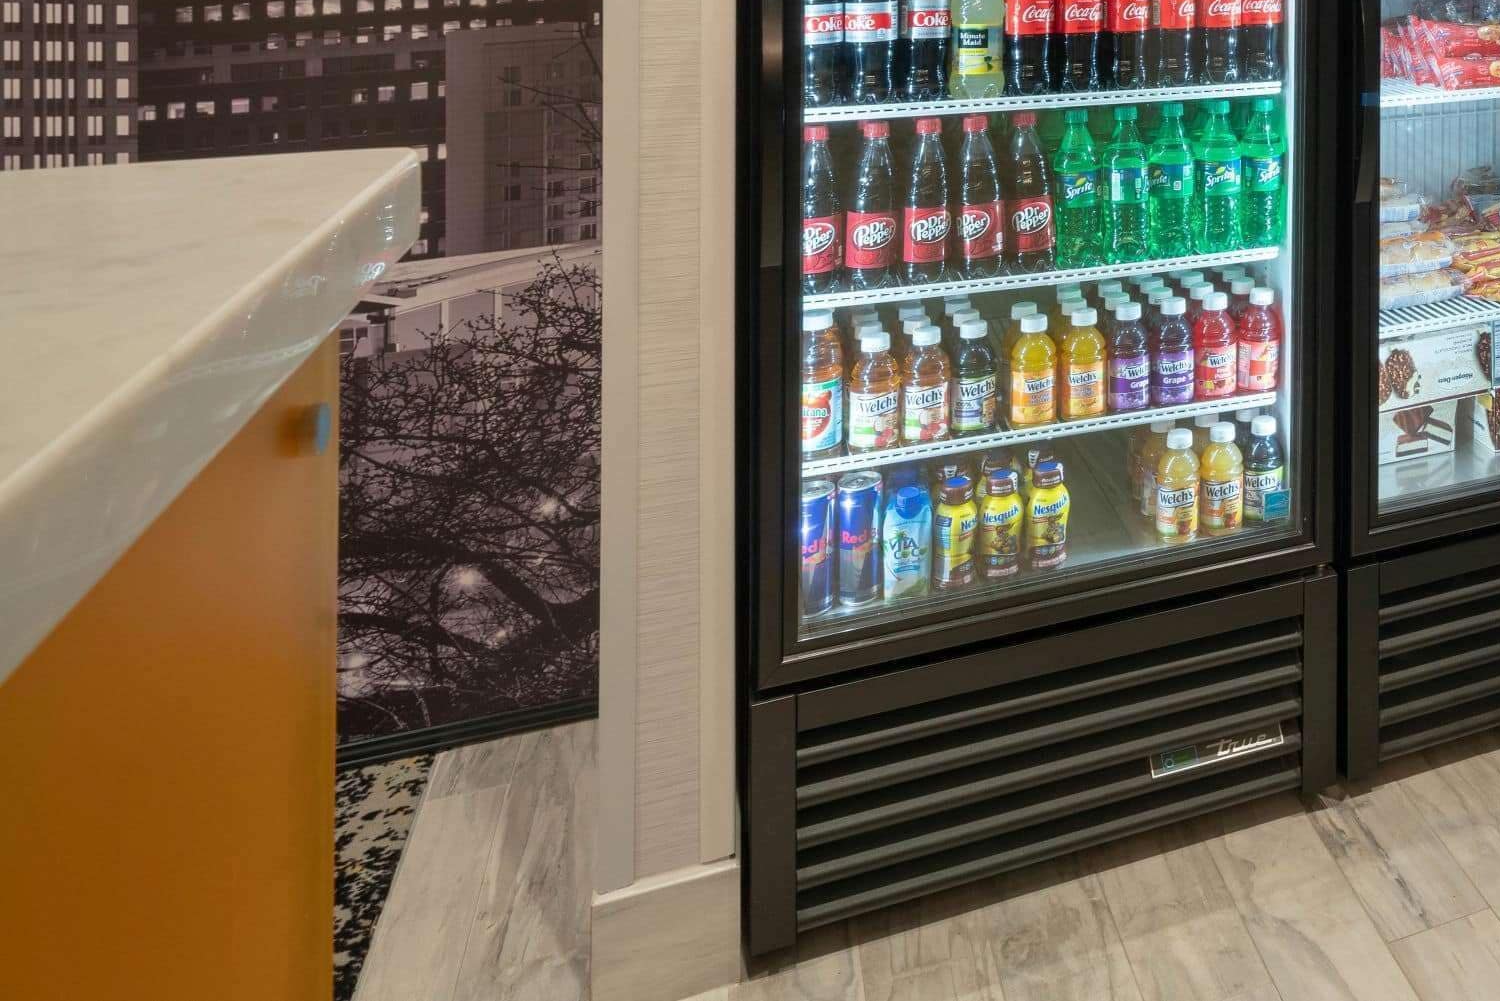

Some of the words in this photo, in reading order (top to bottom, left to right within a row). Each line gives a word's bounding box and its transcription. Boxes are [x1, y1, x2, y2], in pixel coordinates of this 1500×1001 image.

[807, 14, 842, 33] Coke
[913, 11, 948, 27] Coke
[960, 32, 985, 40] Minute
[963, 38, 982, 47] Maid
[1066, 182, 1093, 199] Sprite
[928, 215, 944, 226] Dr
[963, 213, 974, 226] Dr
[1016, 208, 1048, 232] Pepper
[1024, 206, 1039, 218] Dr
[857, 223, 893, 247] Pepper
[870, 221, 886, 234] Dr
[960, 376, 996, 398] Welch's
[1163, 375, 1187, 385] Grape
[858, 393, 898, 413] Welch's
[907, 388, 943, 406] Welch's
[1244, 474, 1276, 489] Welch's
[1159, 489, 1193, 505] Welch's
[1205, 483, 1239, 500] Welch's
[1034, 496, 1067, 515] Nesquik
[984, 505, 1019, 524] Nesquik
[1206, 733, 1273, 757] true
